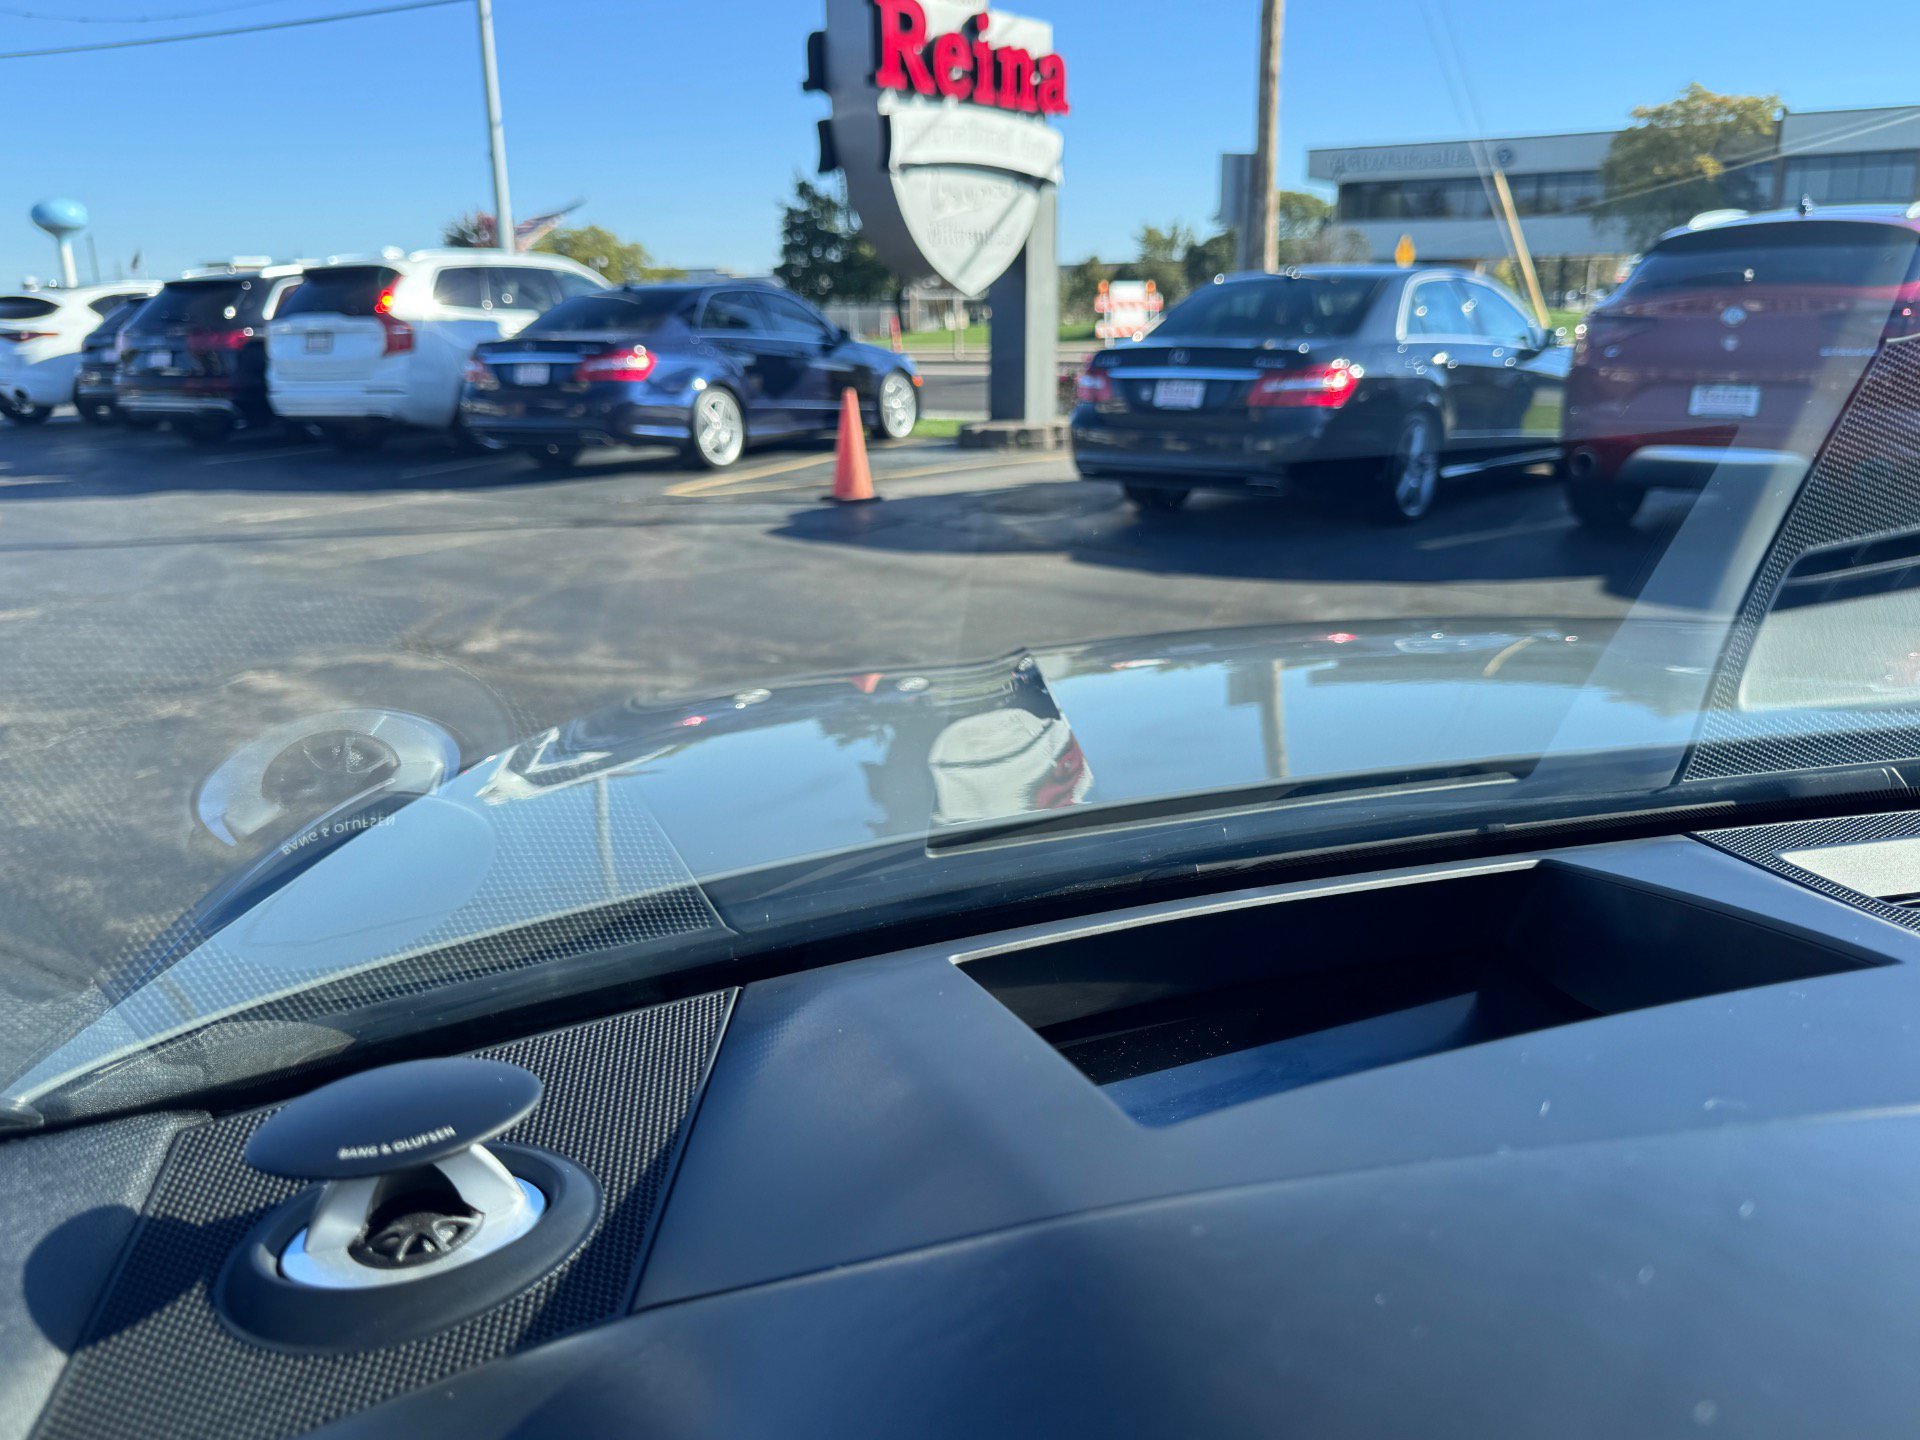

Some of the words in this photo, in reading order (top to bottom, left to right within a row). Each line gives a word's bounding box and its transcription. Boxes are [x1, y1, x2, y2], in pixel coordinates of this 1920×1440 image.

[875, 0, 1069, 115] Reina
[338, 1144, 379, 1160] BANG
[380, 1141, 392, 1156] &
[392, 1124, 457, 1153] OLUFSEN
